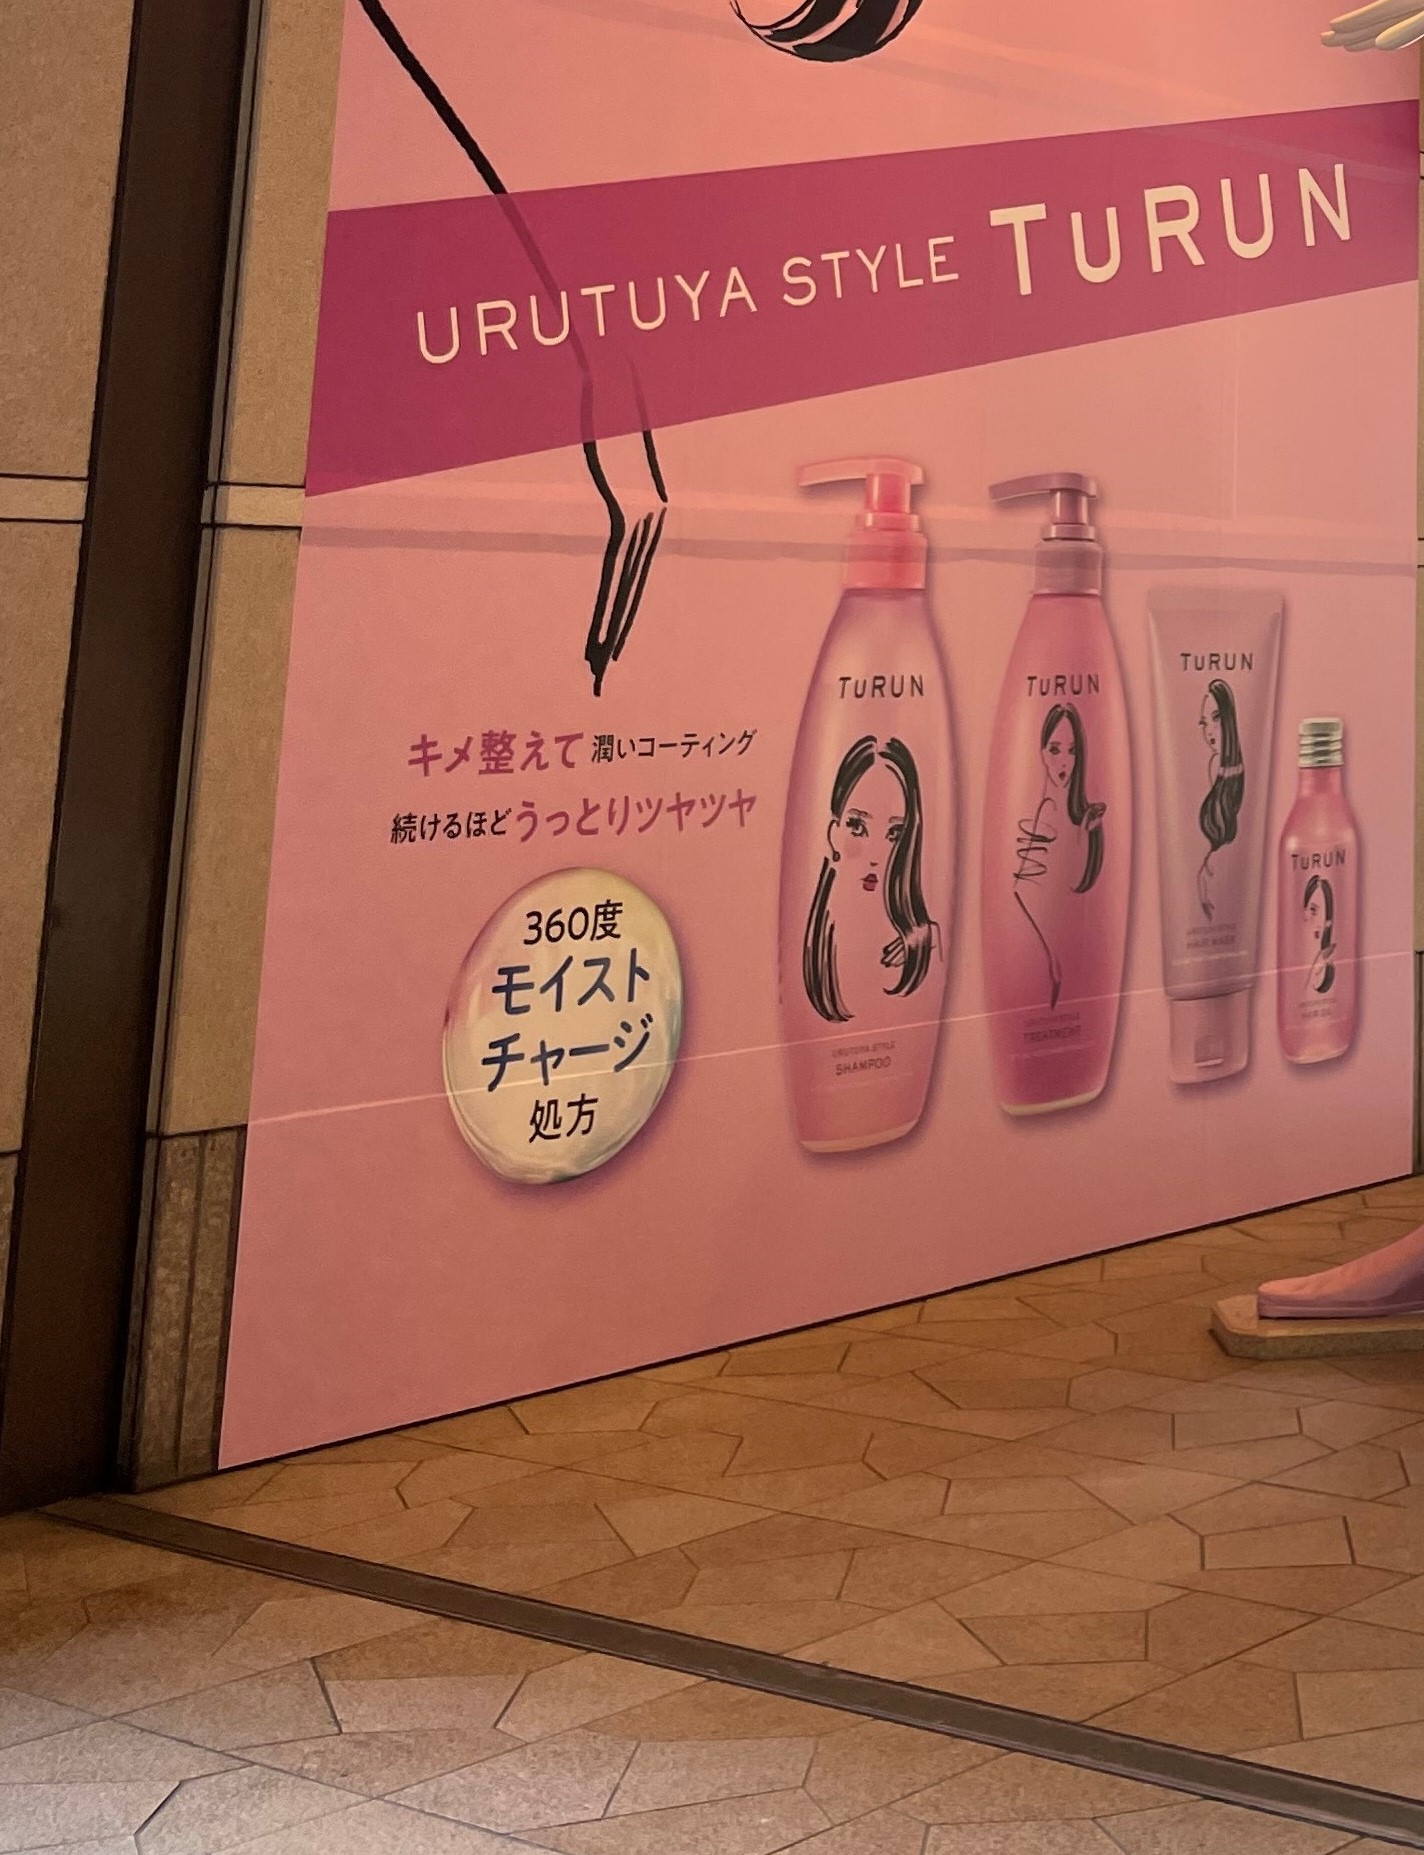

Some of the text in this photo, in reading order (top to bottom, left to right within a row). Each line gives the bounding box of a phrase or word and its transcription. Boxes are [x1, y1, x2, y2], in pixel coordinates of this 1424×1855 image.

[416, 163, 1353, 365] URUTUYA STYLE TURUN
[1180, 652, 1254, 672] TURUN
[839, 674, 925, 699] TURUN
[1027, 674, 1100, 697] TURUN
[1291, 849, 1345, 870] TURUN
[524, 899, 623, 945] 360度
[492, 948, 650, 1015] モイスト
[481, 1013, 653, 1092] チャージ
[529, 1093, 598, 1143] 処方
